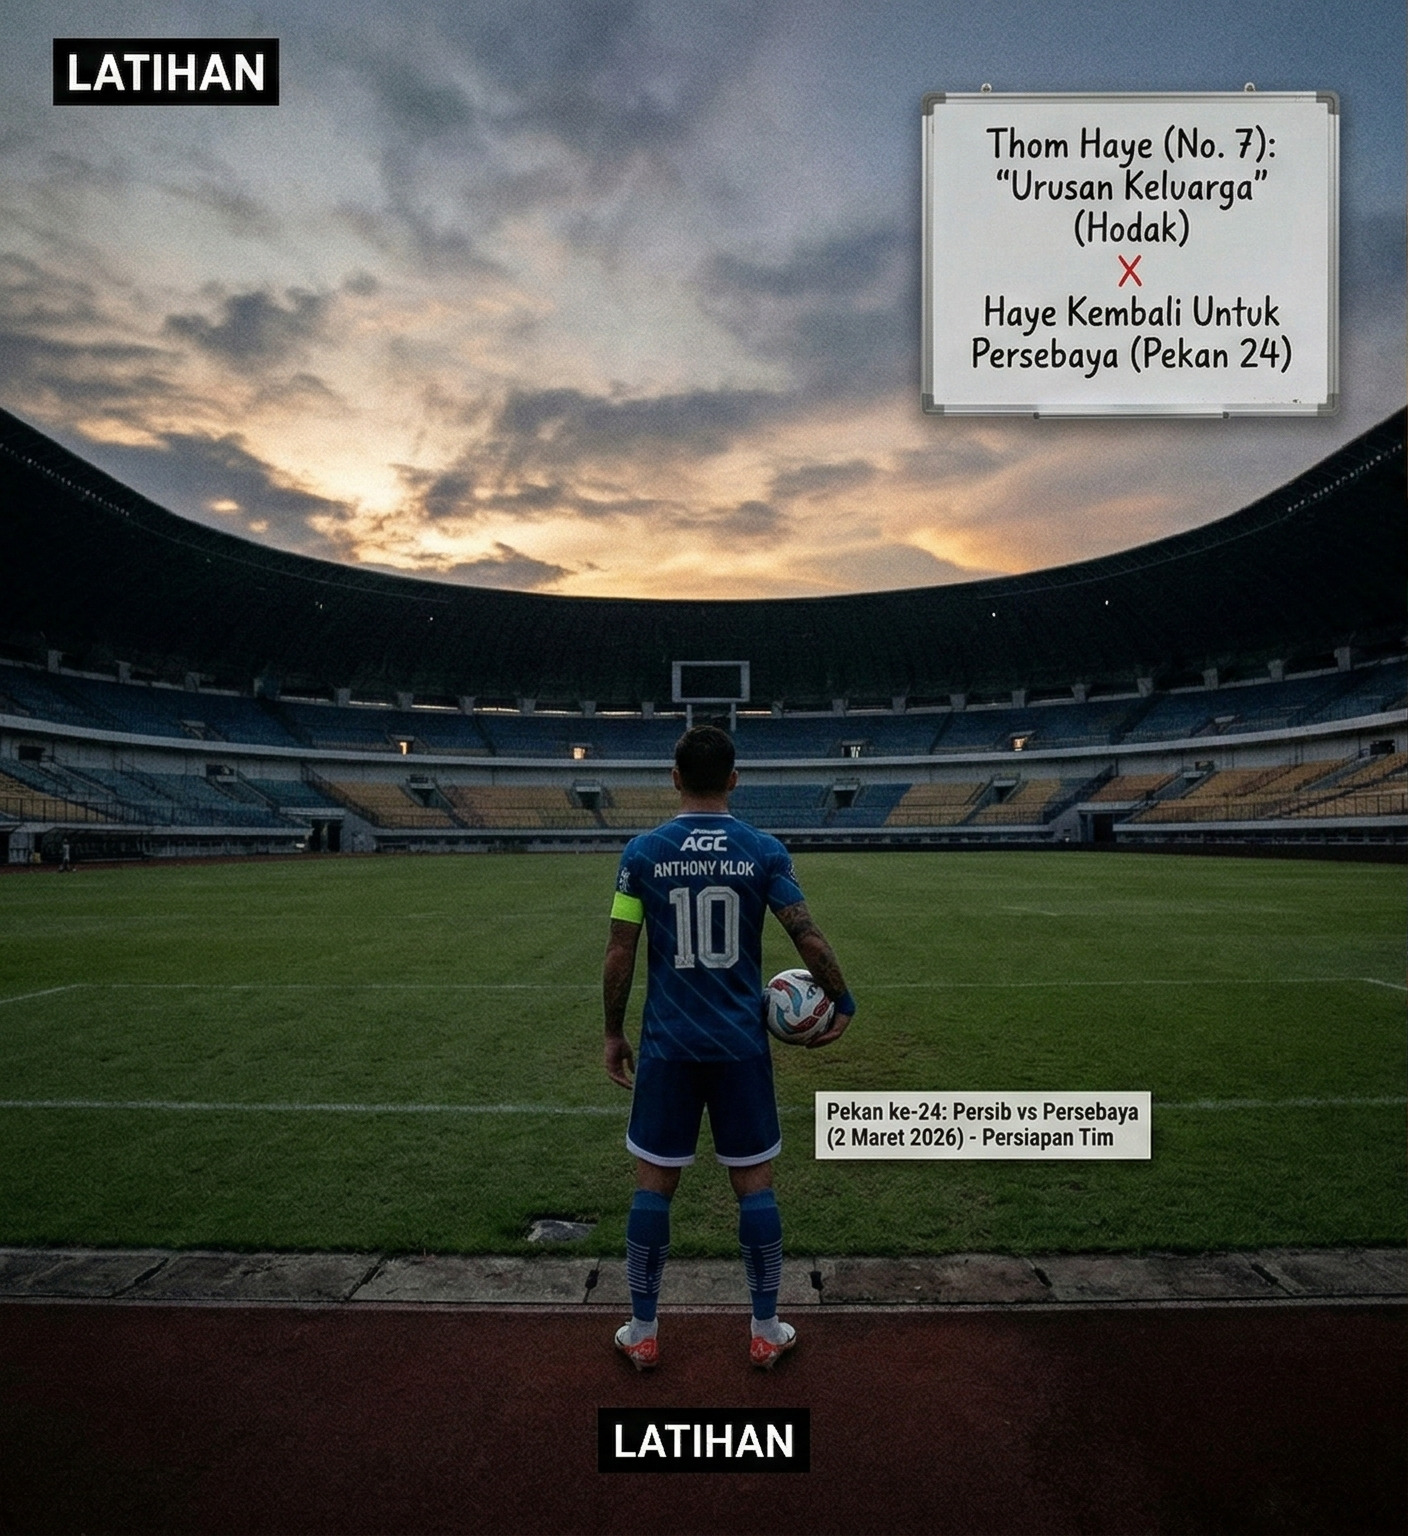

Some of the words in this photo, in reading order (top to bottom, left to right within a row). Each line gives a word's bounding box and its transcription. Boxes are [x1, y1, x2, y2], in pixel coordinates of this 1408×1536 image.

[987, 127, 1068, 158] Thom
[1081, 127, 1152, 168] Haye
[1165, 125, 1224, 163] (No.
[1236, 125, 1275, 163] 7):
[997, 169, 1112, 200] “Urusan
[1126, 169, 1267, 210] Keluarga”
[1075, 209, 1189, 247] (Hodak)
[985, 295, 1056, 336] Haye
[1069, 295, 1180, 326] Kembali
[1194, 295, 1279, 327] Untuk
[973, 337, 1118, 378] Persebaya
[1131, 336, 1227, 373] (Pekan
[1241, 335, 1291, 373] 24)
[680, 836, 727, 851] AGC
[654, 861, 716, 877] ANTHONY
[721, 860, 754, 876] KLOK
[669, 886, 739, 968] 10
